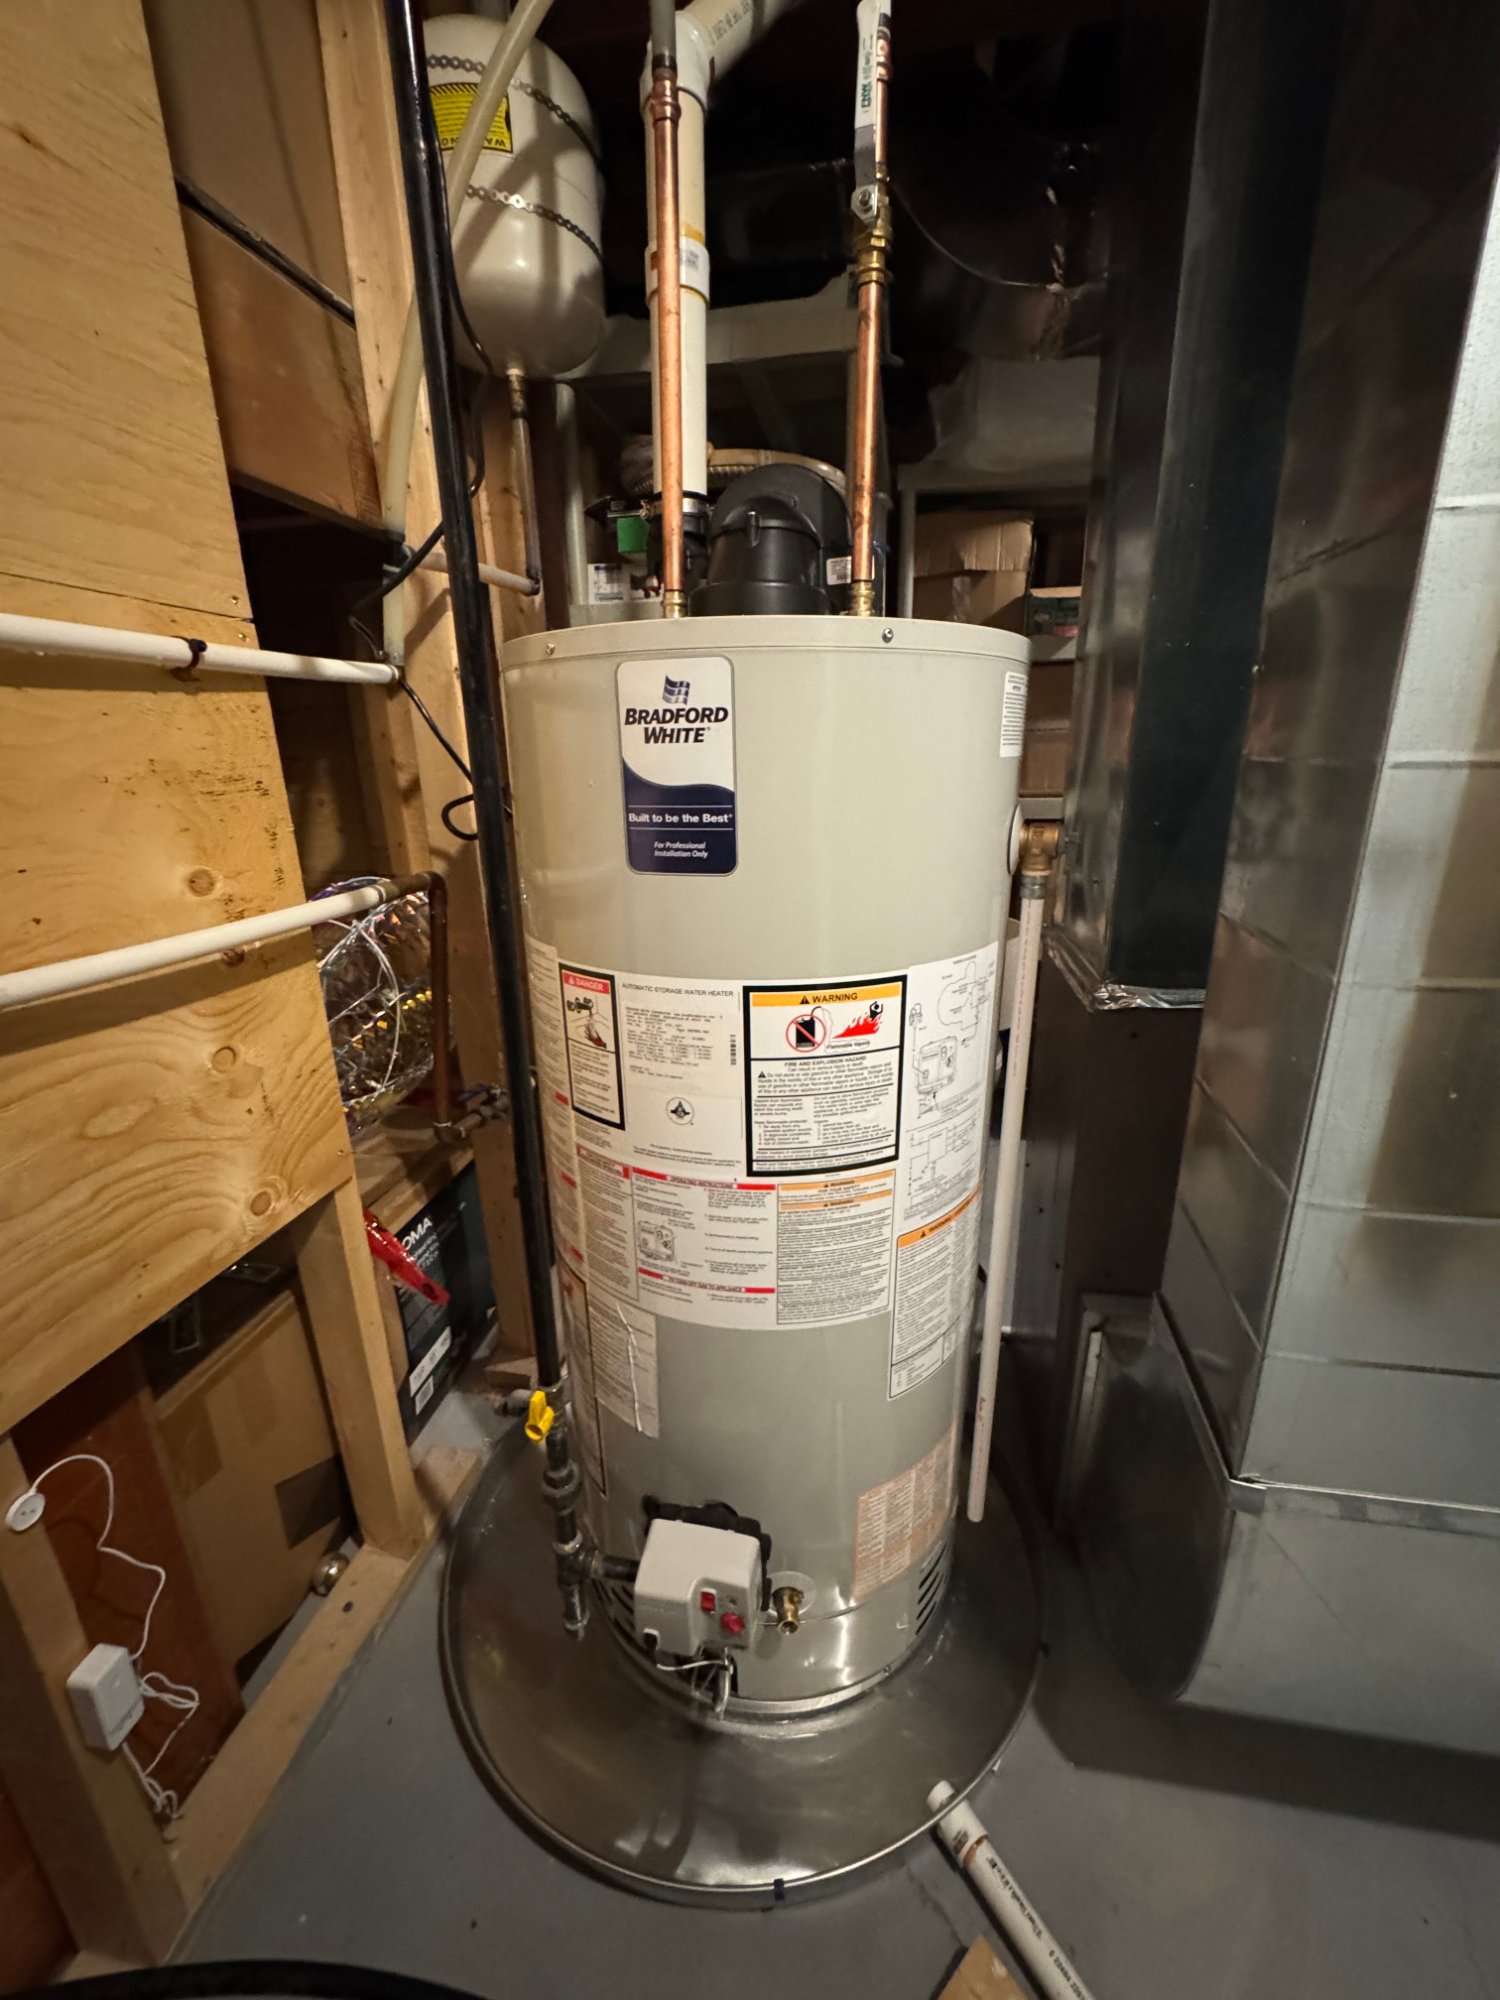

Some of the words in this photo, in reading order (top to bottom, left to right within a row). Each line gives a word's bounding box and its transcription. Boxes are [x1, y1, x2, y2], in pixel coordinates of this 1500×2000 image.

[624, 707, 729, 725] BRADFORD
[643, 727, 706, 744] WHITE
[628, 813, 650, 823] Built
[652, 814, 663, 823] to
[665, 813, 679, 823] be
[682, 813, 700, 823] the
[702, 813, 729, 823] Best
[654, 841, 665, 849] For
[666, 841, 706, 849] Professional
[654, 850, 691, 858] Installation
[692, 851, 708, 859] Only
[575, 978, 606, 992] DANGER
[621, 983, 653, 993] AUTOMATIC
[654, 986, 683, 995] STORAGE
[684, 988, 707, 996] WATER
[708, 989, 734, 997] HEATER
[812, 992, 858, 1004] WARNING
